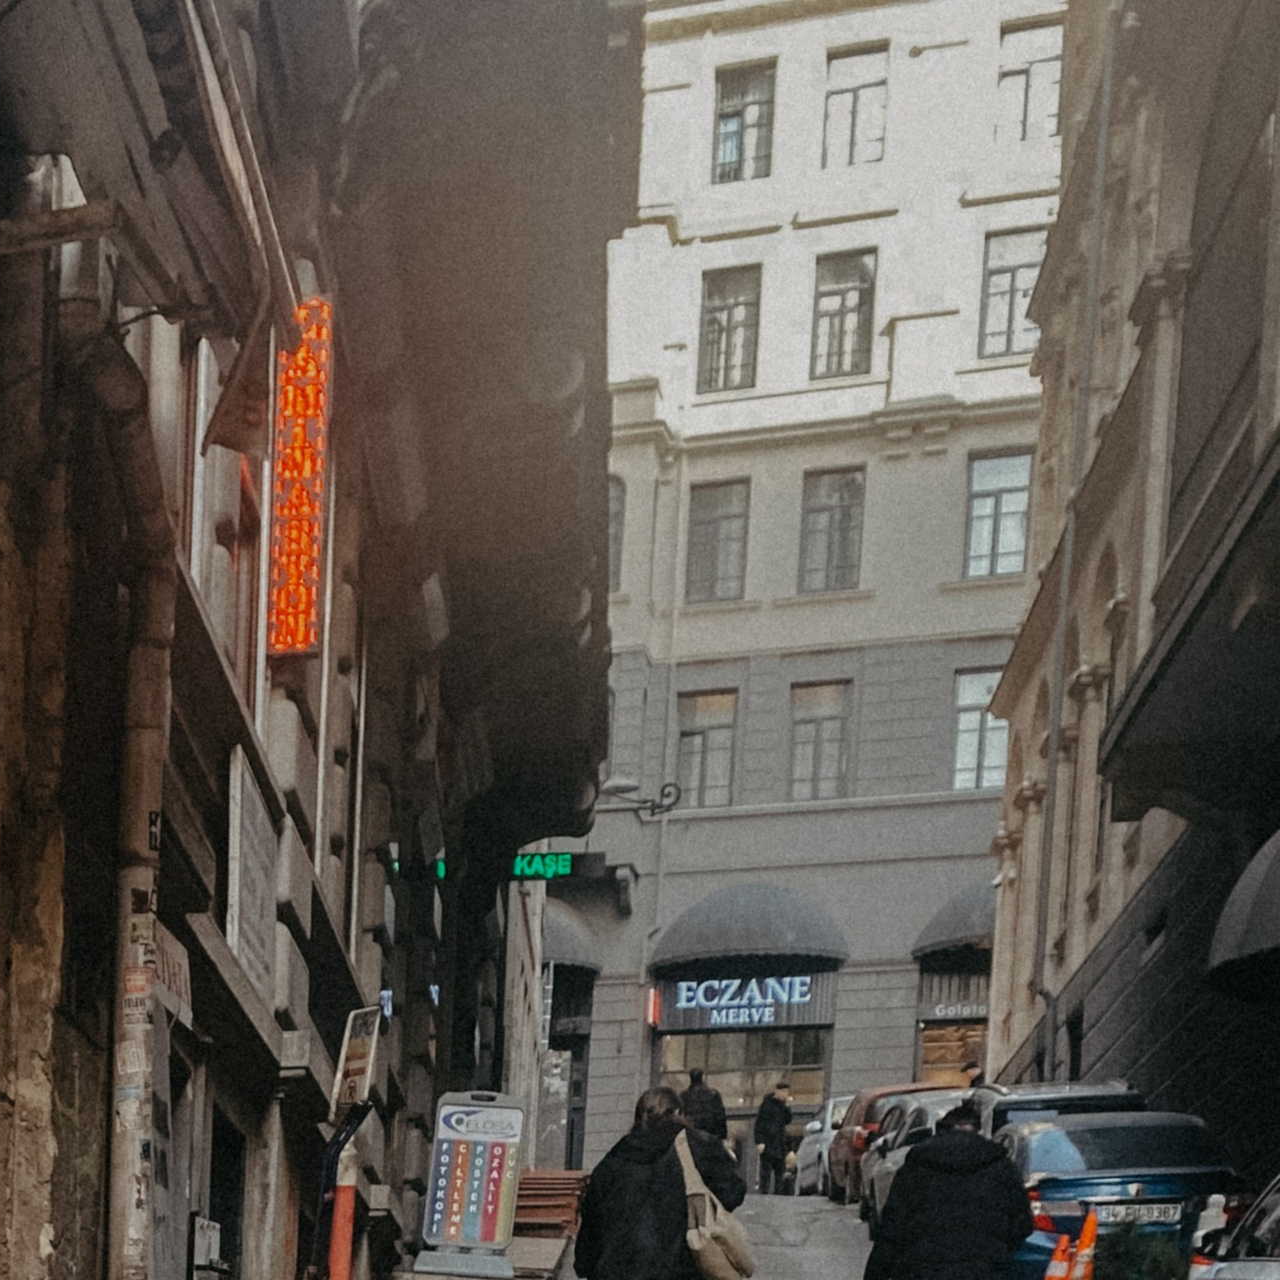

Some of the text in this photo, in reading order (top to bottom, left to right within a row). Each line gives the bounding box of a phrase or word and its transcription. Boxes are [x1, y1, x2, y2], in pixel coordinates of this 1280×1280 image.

[513, 853, 572, 879] KAŞE
[676, 975, 812, 1009] ECZANE
[710, 1007, 775, 1026] MERVE
[469, 1145, 484, 1213] POSTER
[506, 1147, 517, 1179] PVC
